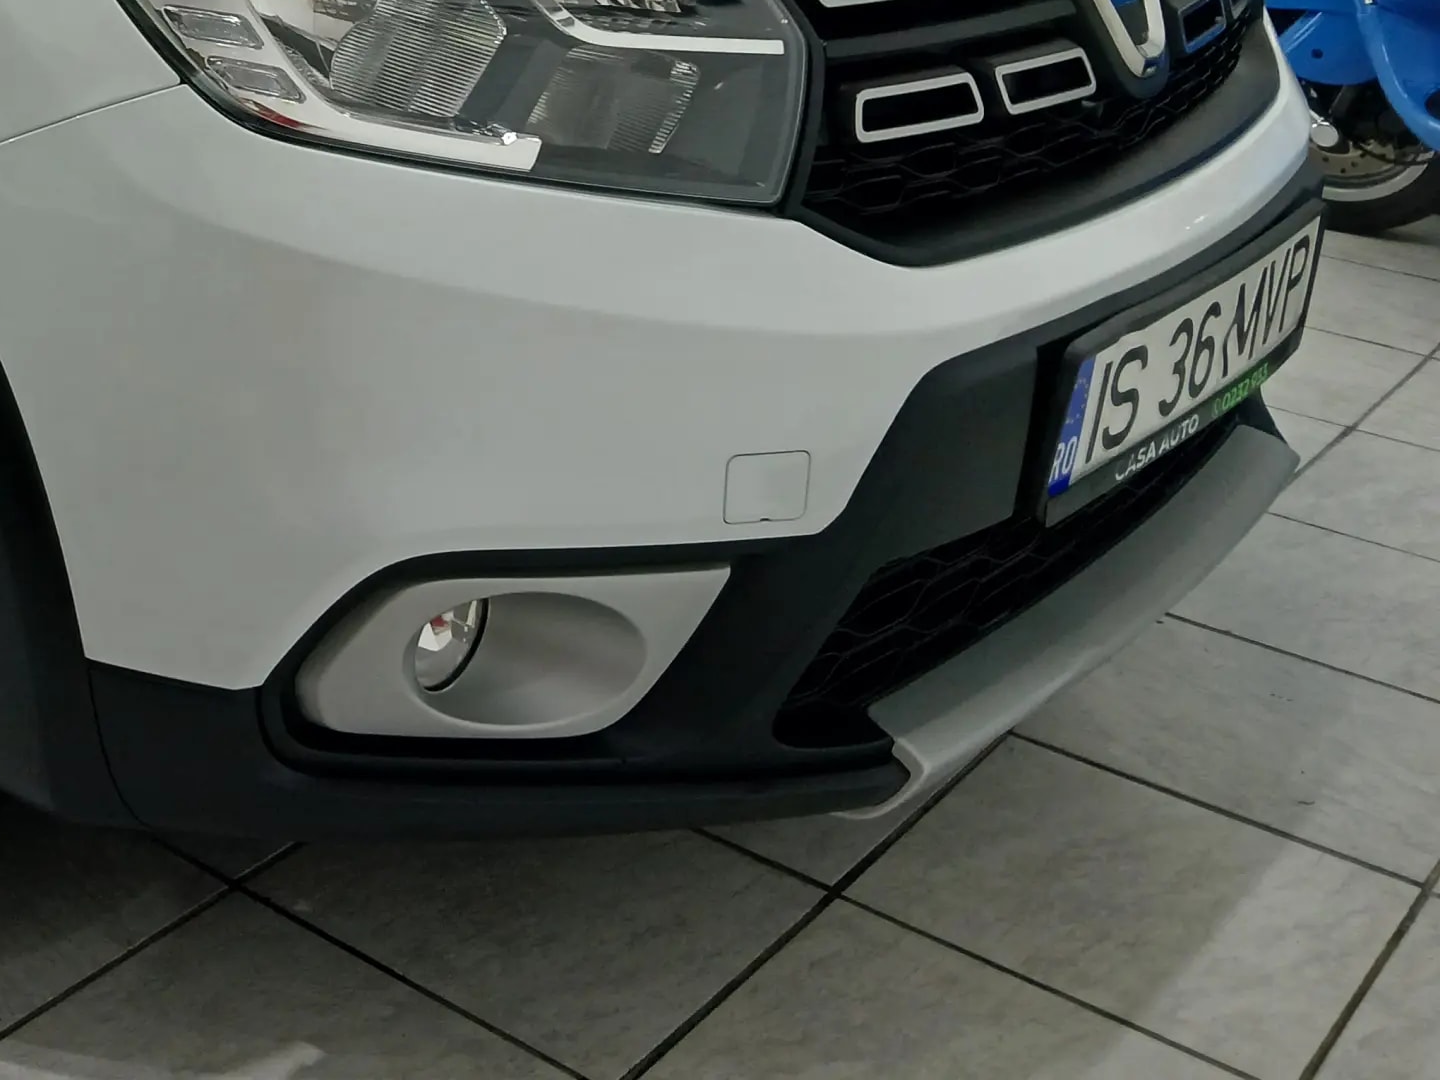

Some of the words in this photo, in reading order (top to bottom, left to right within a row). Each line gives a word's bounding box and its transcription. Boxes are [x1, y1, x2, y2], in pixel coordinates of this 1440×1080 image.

[1085, 345, 1148, 464] IS
[1159, 301, 1221, 416] 36
[1220, 234, 1311, 378] MVP
[1157, 414, 1199, 454] AUTO
[1049, 435, 1078, 484] RO
